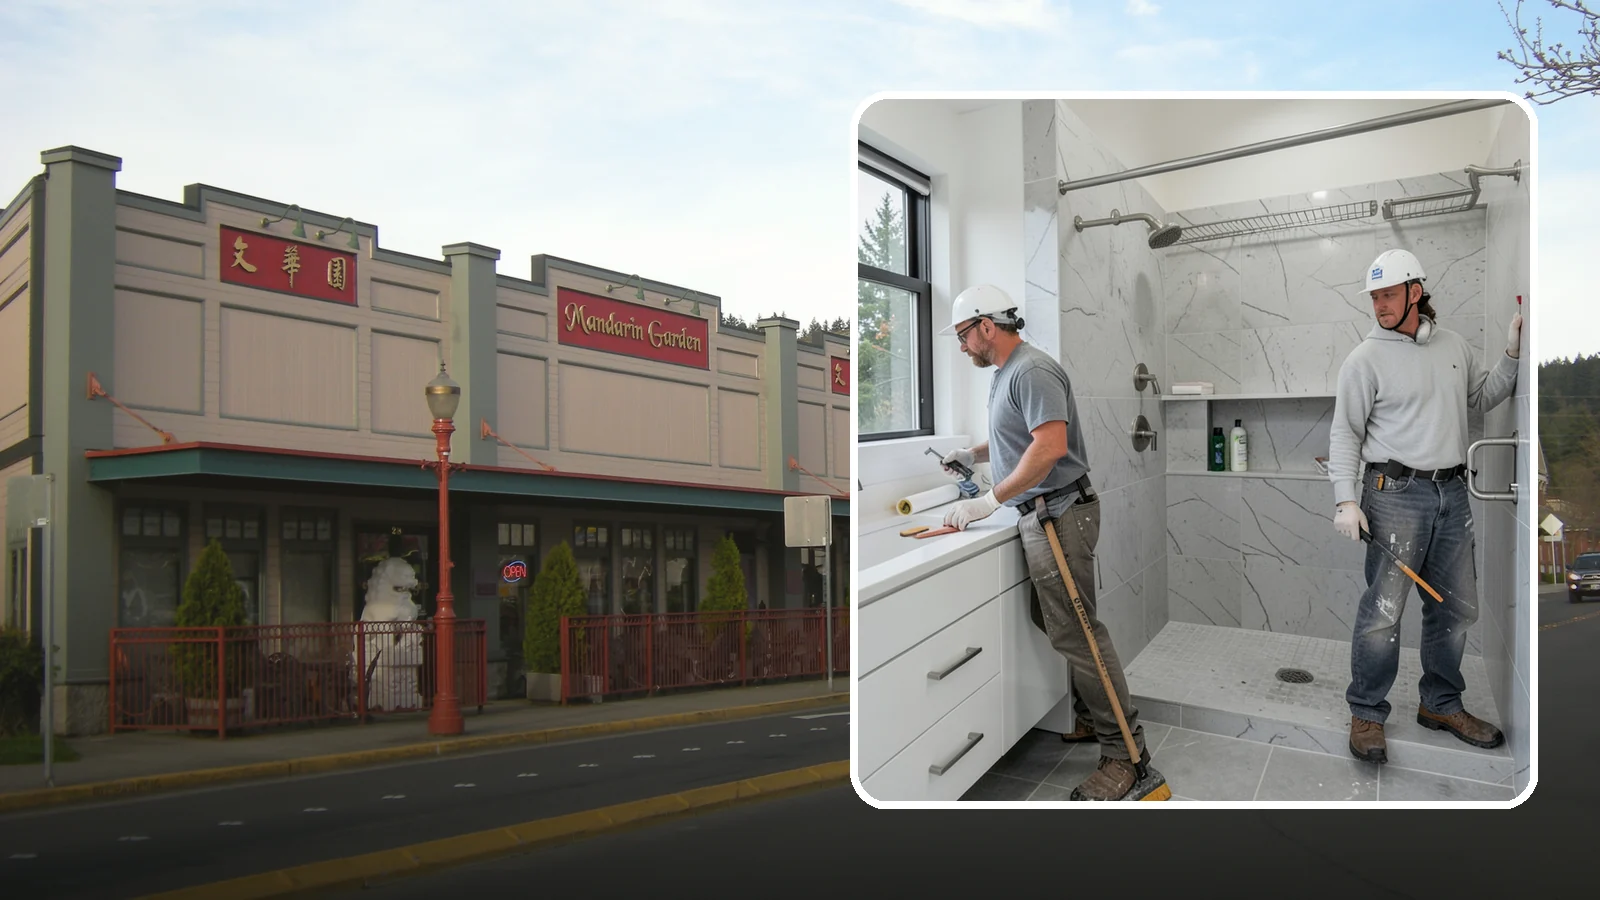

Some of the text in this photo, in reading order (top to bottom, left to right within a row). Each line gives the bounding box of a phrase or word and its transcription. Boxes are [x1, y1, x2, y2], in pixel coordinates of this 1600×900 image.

[231, 236, 347, 290] 文華園
[564, 302, 701, 352] Mandarin Garden
[835, 363, 846, 386] 文
[503, 565, 527, 578] OPEN
